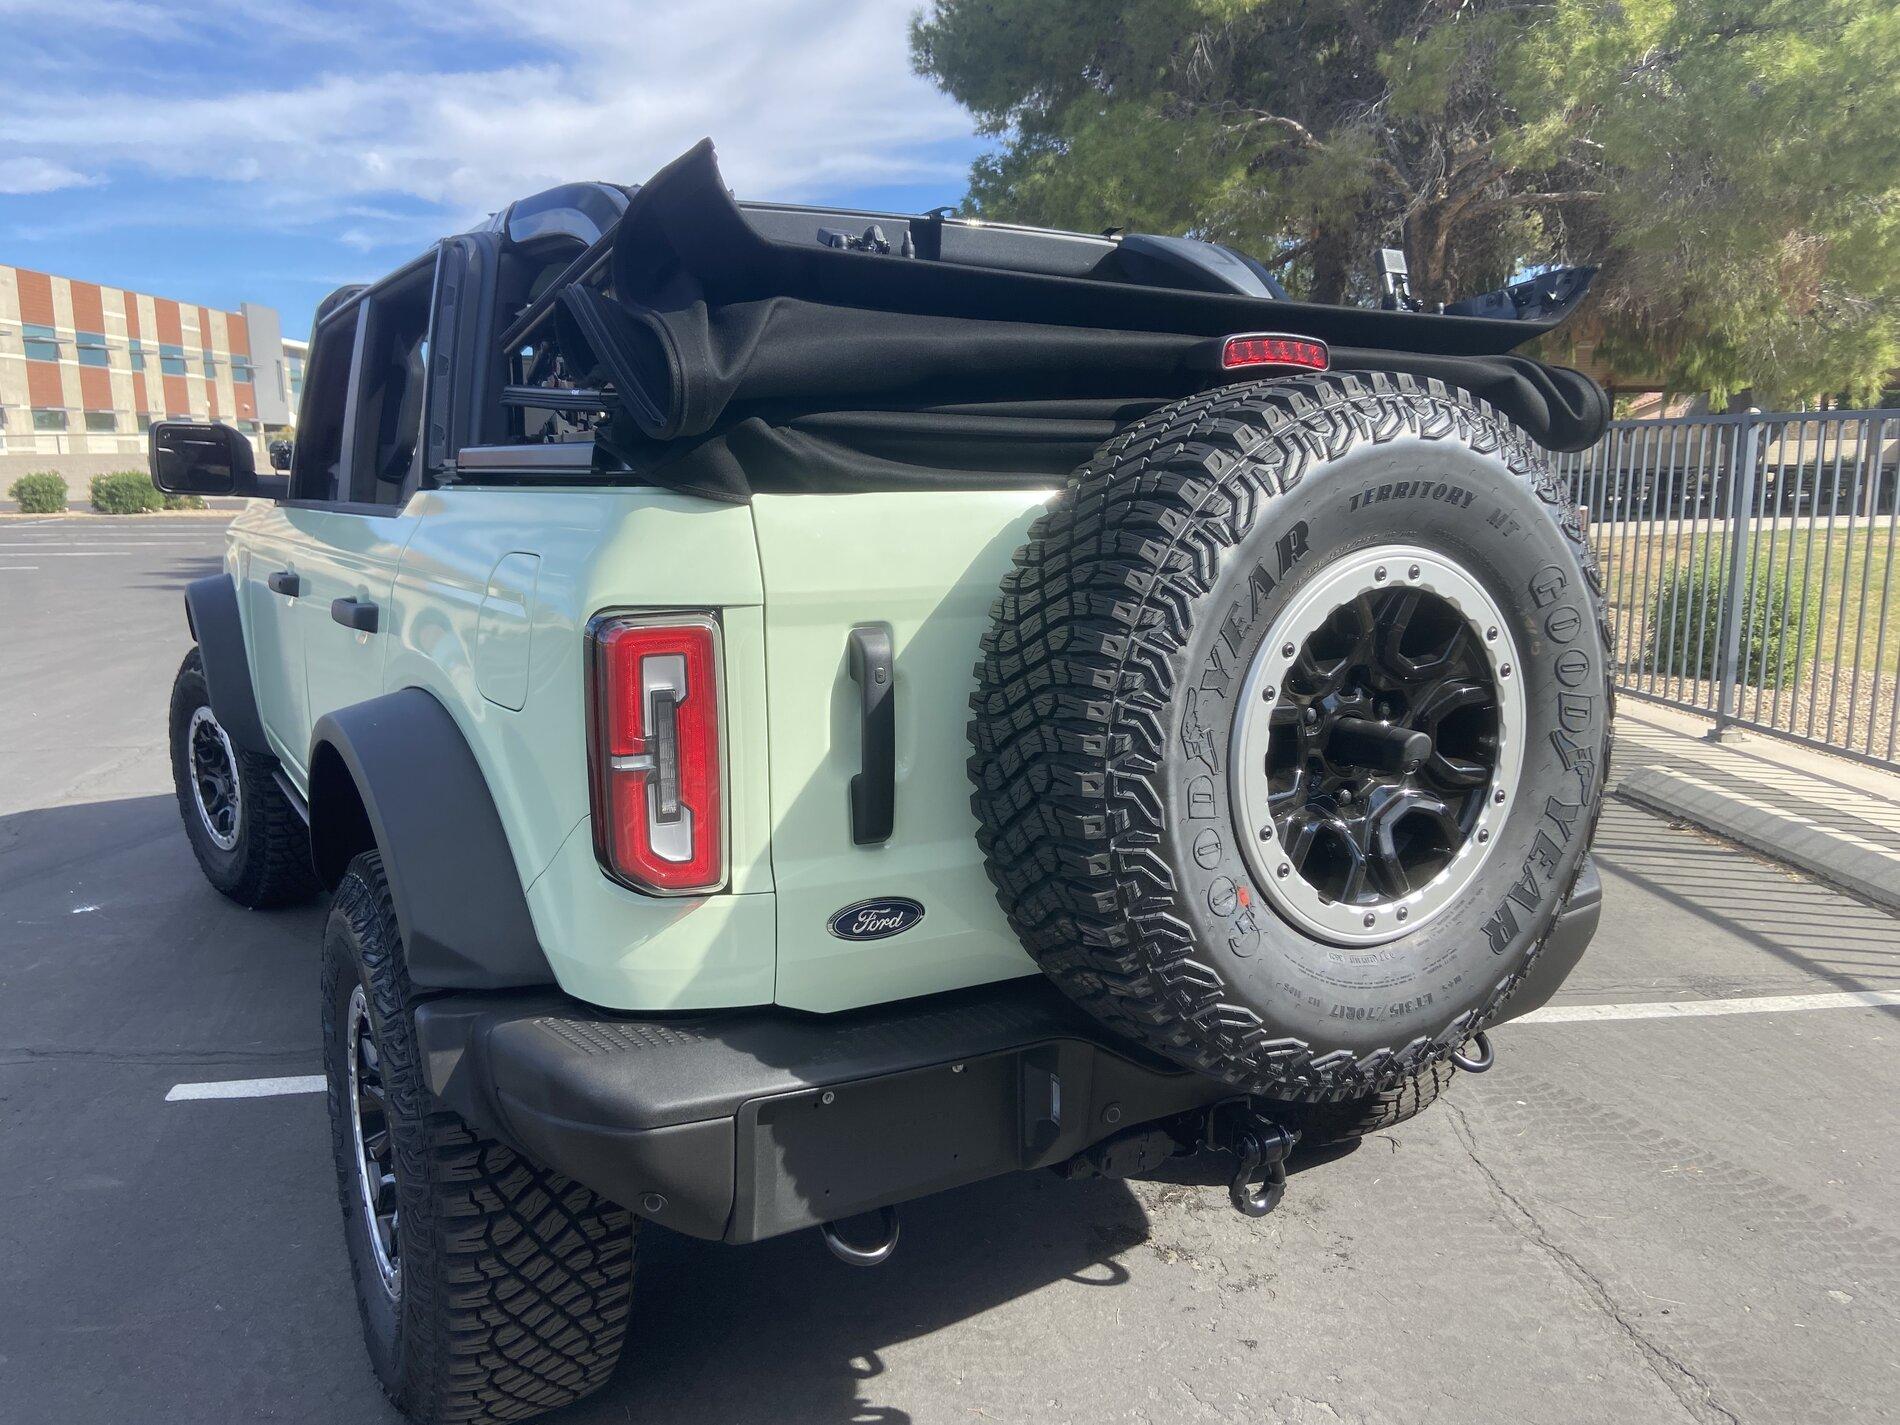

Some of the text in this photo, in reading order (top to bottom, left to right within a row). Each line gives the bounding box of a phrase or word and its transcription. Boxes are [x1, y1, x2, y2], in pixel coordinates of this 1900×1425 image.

[1349, 481, 1521, 537] TERRITORY MT
[852, 907, 904, 934] Ford
[1328, 993, 1433, 1022] LT315/70R17
